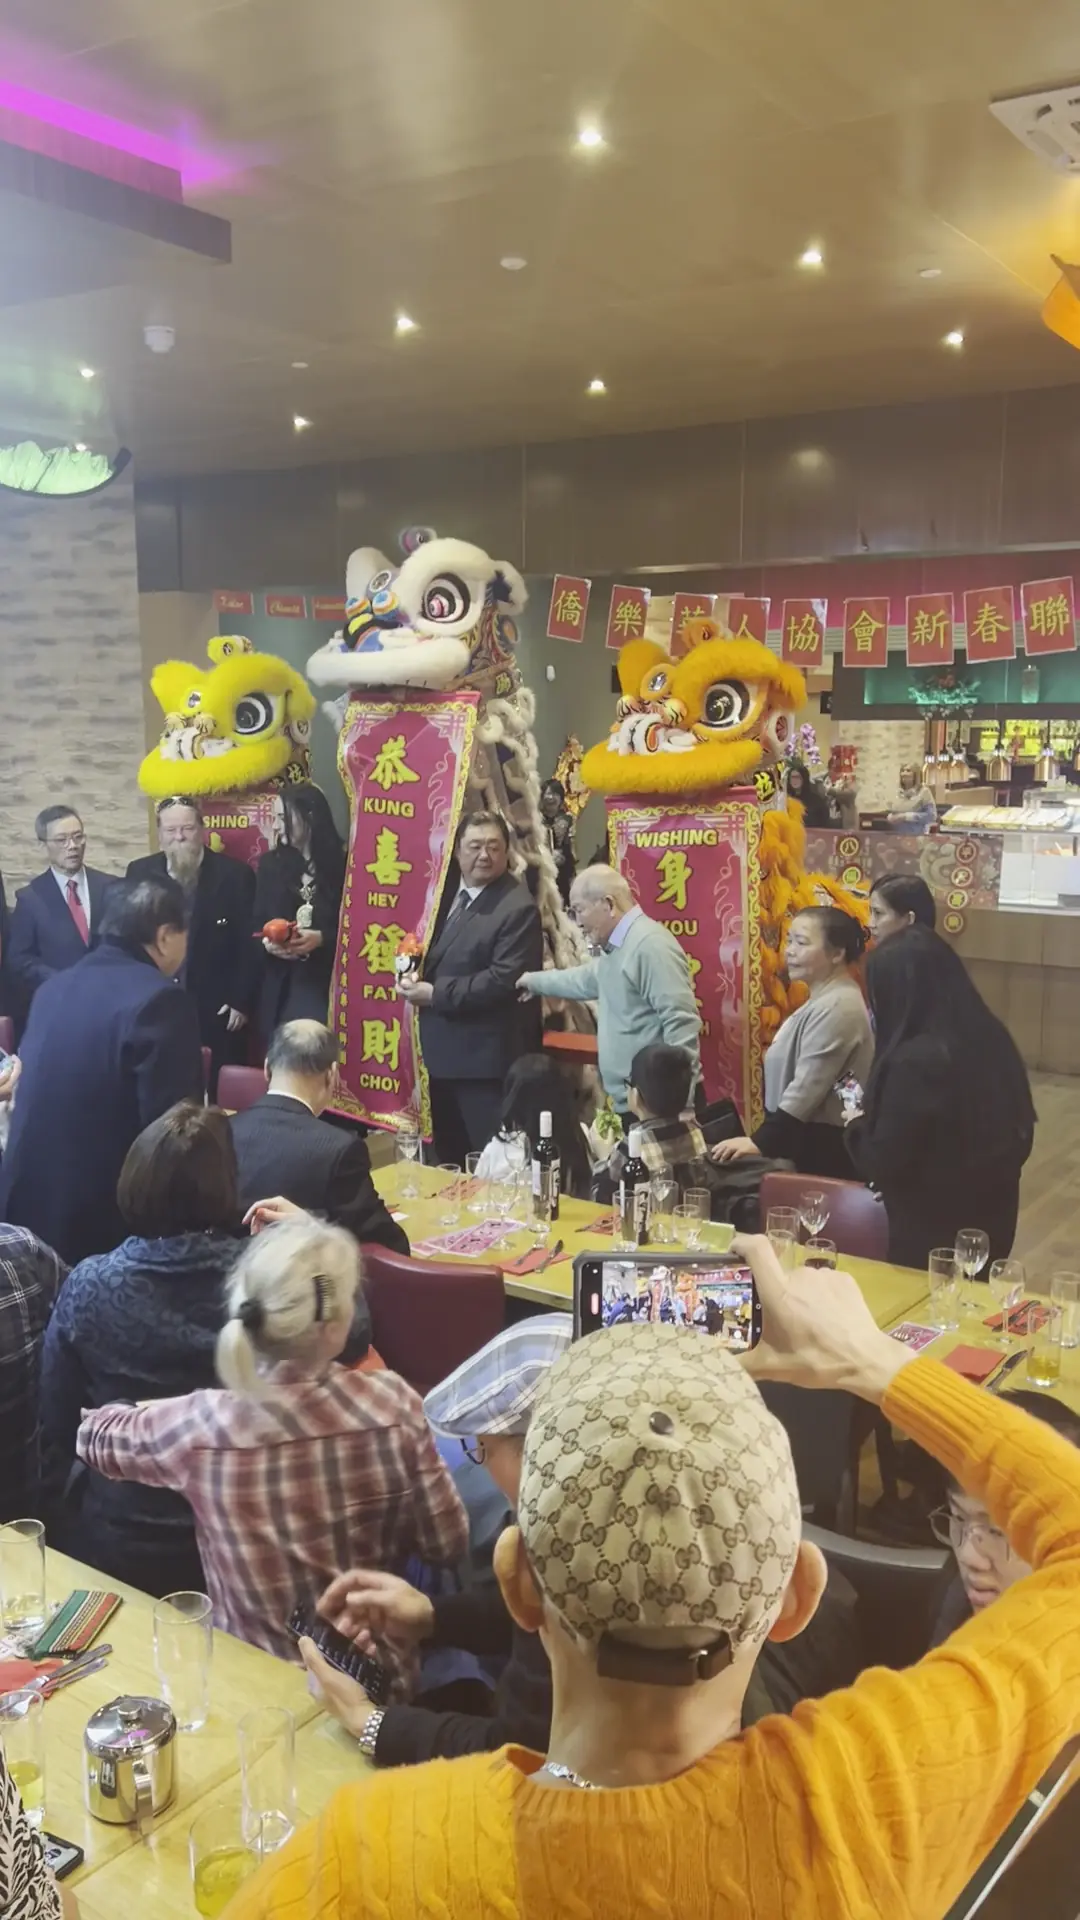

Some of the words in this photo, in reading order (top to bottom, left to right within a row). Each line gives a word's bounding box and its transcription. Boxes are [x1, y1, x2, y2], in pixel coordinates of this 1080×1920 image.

[369, 735, 420, 790] 恭
[363, 799, 415, 818] KUNG
[202, 815, 249, 828] SHING
[635, 829, 719, 848] WISHING
[366, 826, 412, 886] 喜
[656, 849, 692, 910] 身
[367, 892, 399, 909] HEY
[363, 984, 398, 1002] FAT
[361, 1019, 401, 1072] 財
[360, 1073, 401, 1093] CHOY
